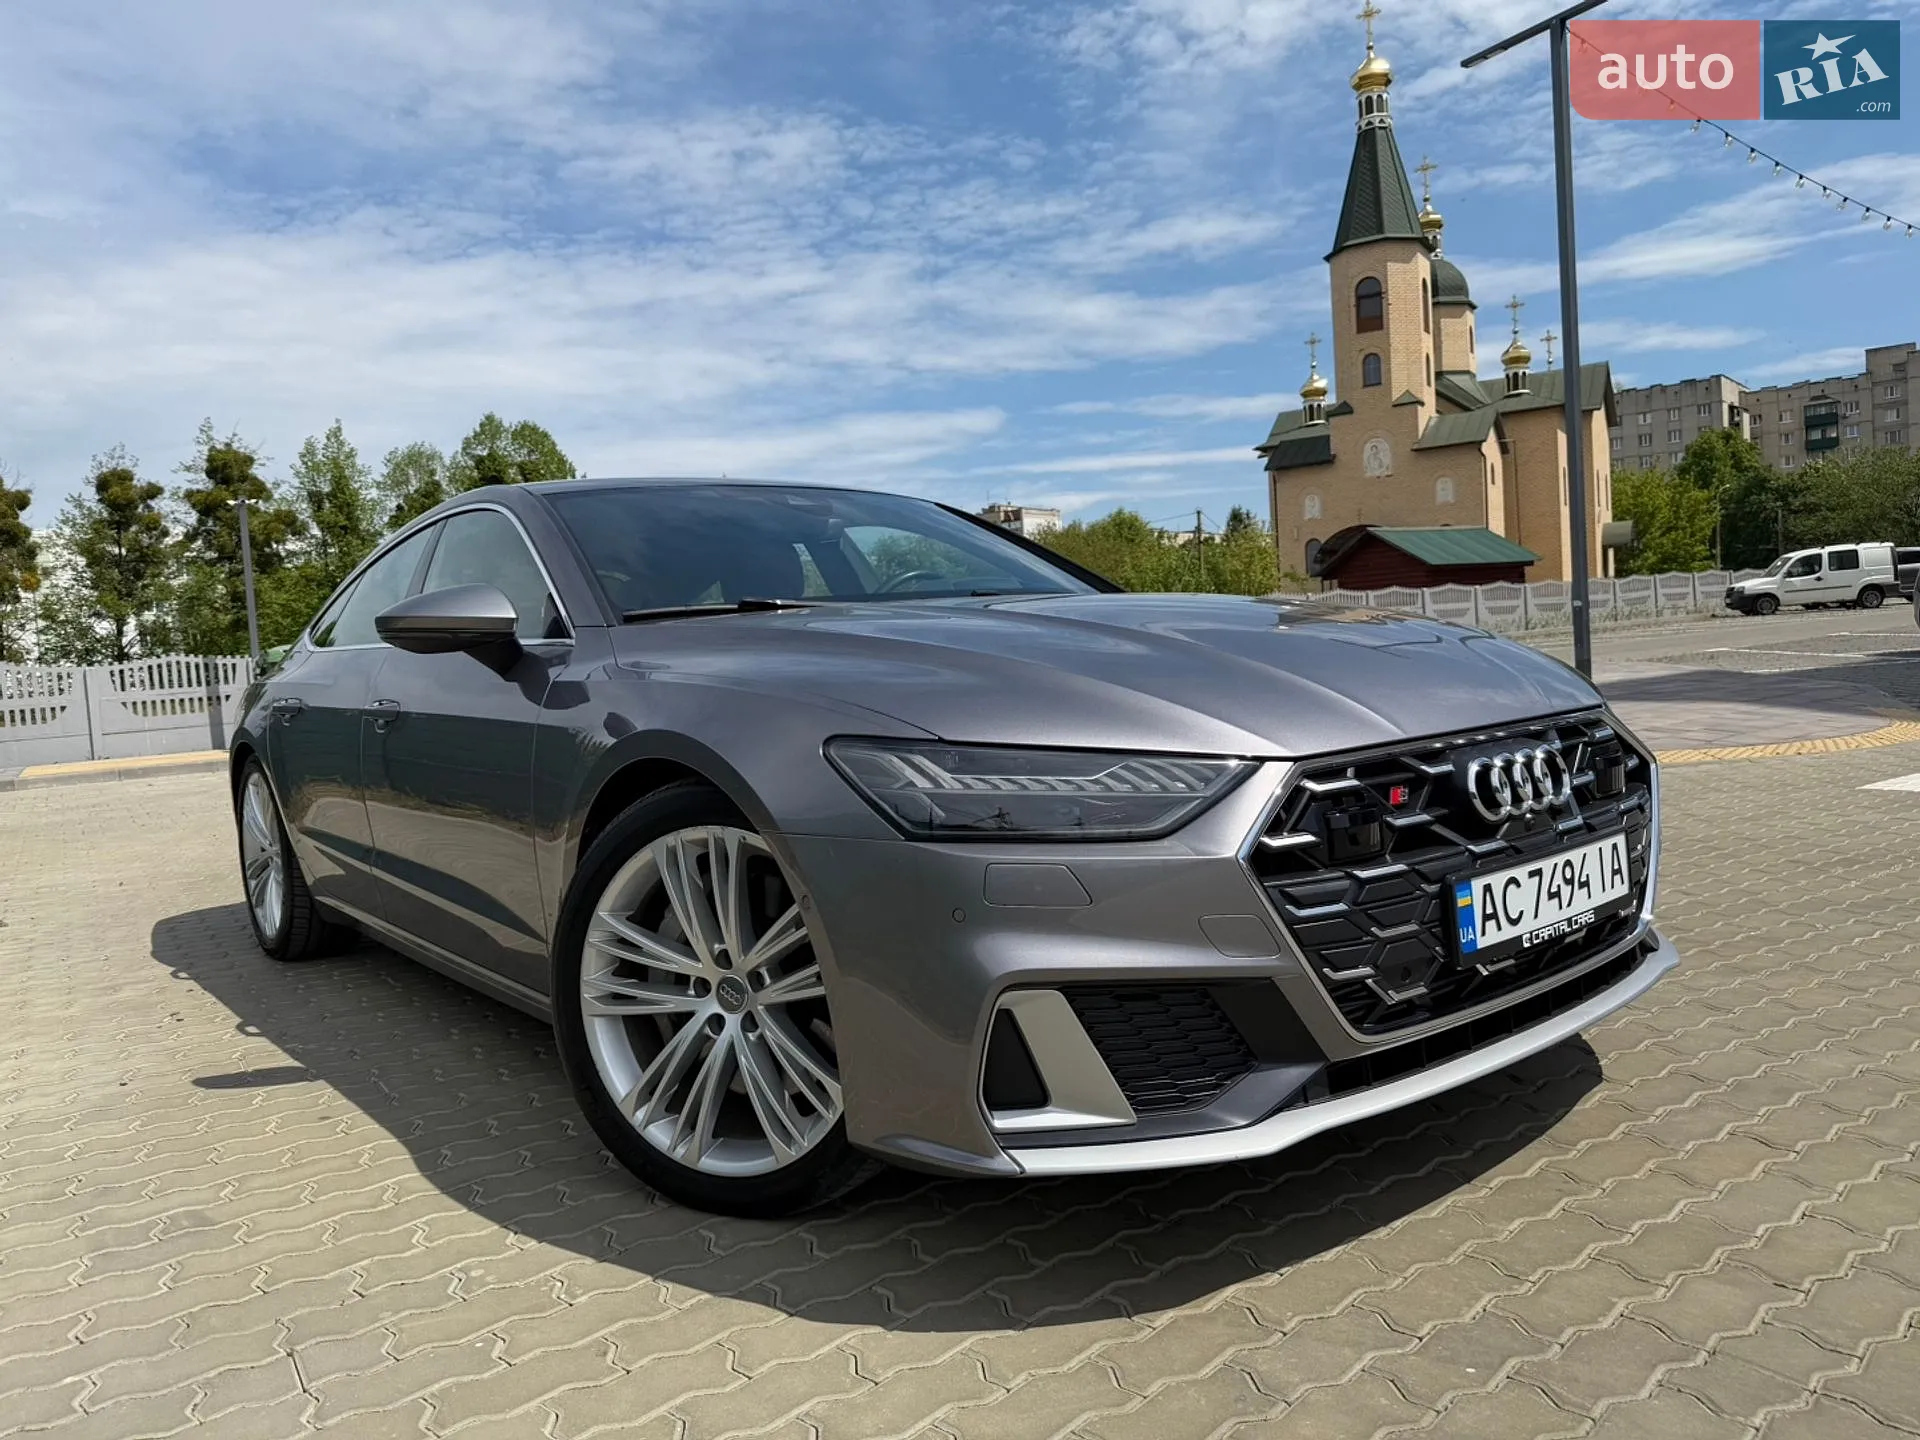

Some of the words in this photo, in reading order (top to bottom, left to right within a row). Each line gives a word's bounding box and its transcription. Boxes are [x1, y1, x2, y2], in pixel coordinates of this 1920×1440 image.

[1480, 876, 1524, 937] AC
[1528, 852, 1592, 919] 7494
[1599, 842, 1625, 893] IA
[1459, 926, 1476, 943] UA
[1532, 920, 1572, 944] CAPITAL
[1572, 910, 1595, 929] CARS
